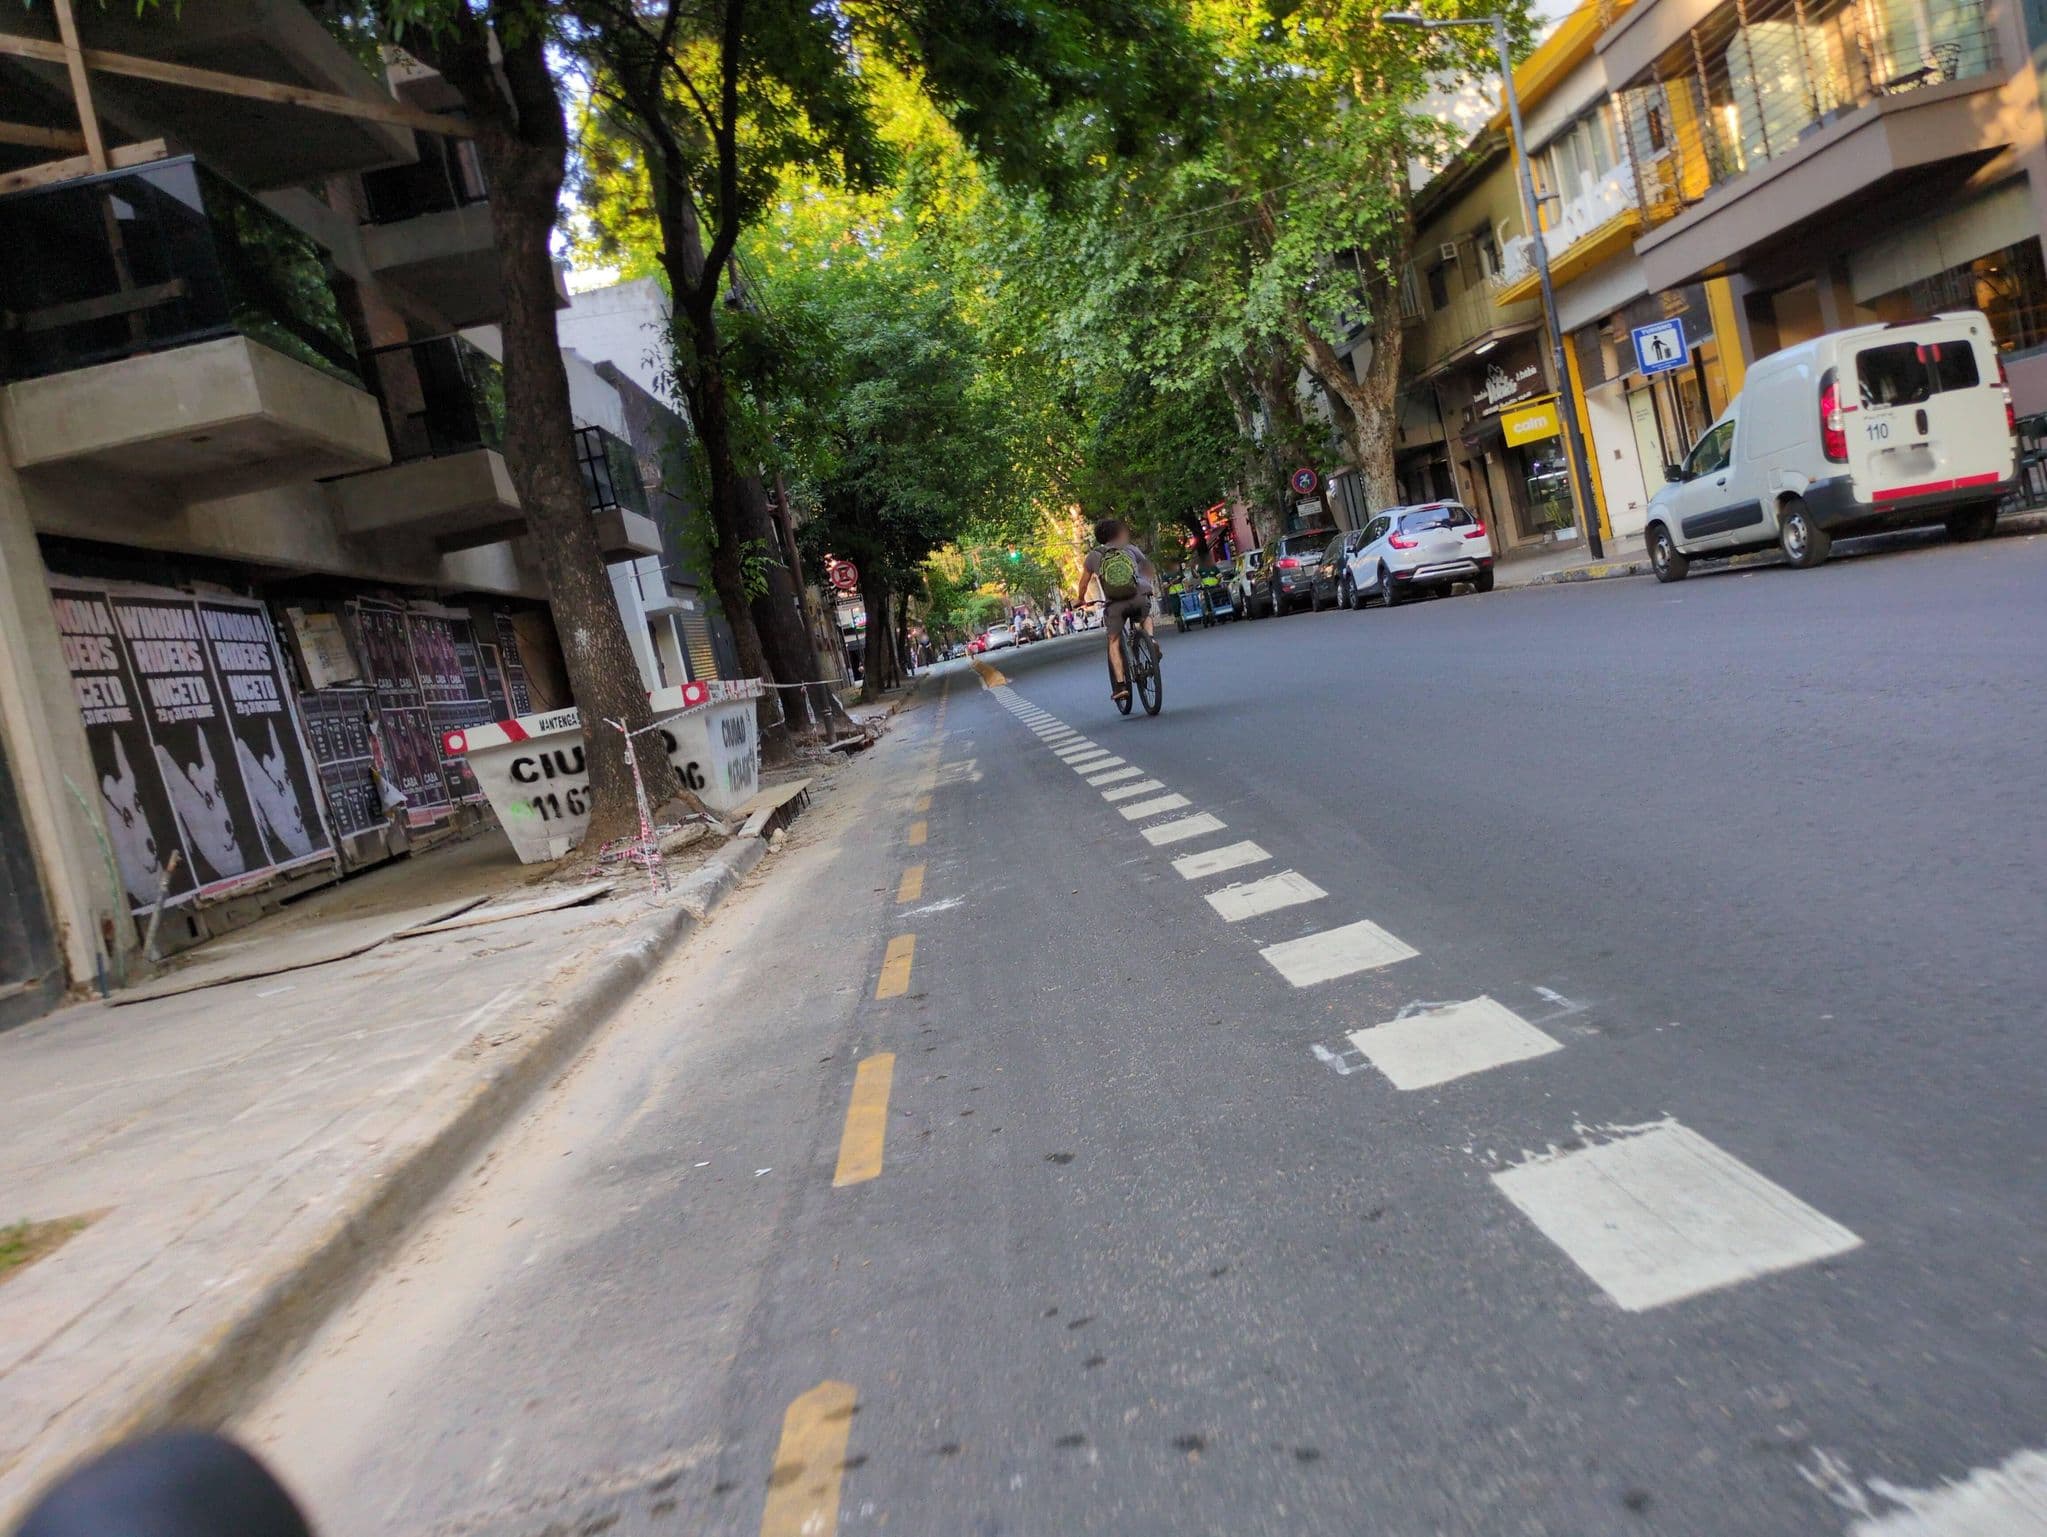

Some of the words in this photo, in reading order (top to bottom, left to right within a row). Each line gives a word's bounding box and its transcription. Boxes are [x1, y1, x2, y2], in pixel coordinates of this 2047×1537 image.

[1866, 422, 1889, 440] 110
[114, 606, 200, 639] WINONA
[202, 609, 269, 642] WINONA
[132, 640, 204, 673] RIDERS
[214, 641, 272, 671] RIDERS
[147, 676, 211, 708] NICETO
[226, 675, 278, 701] NICETO
[539, 713, 578, 732] MANTENGA
